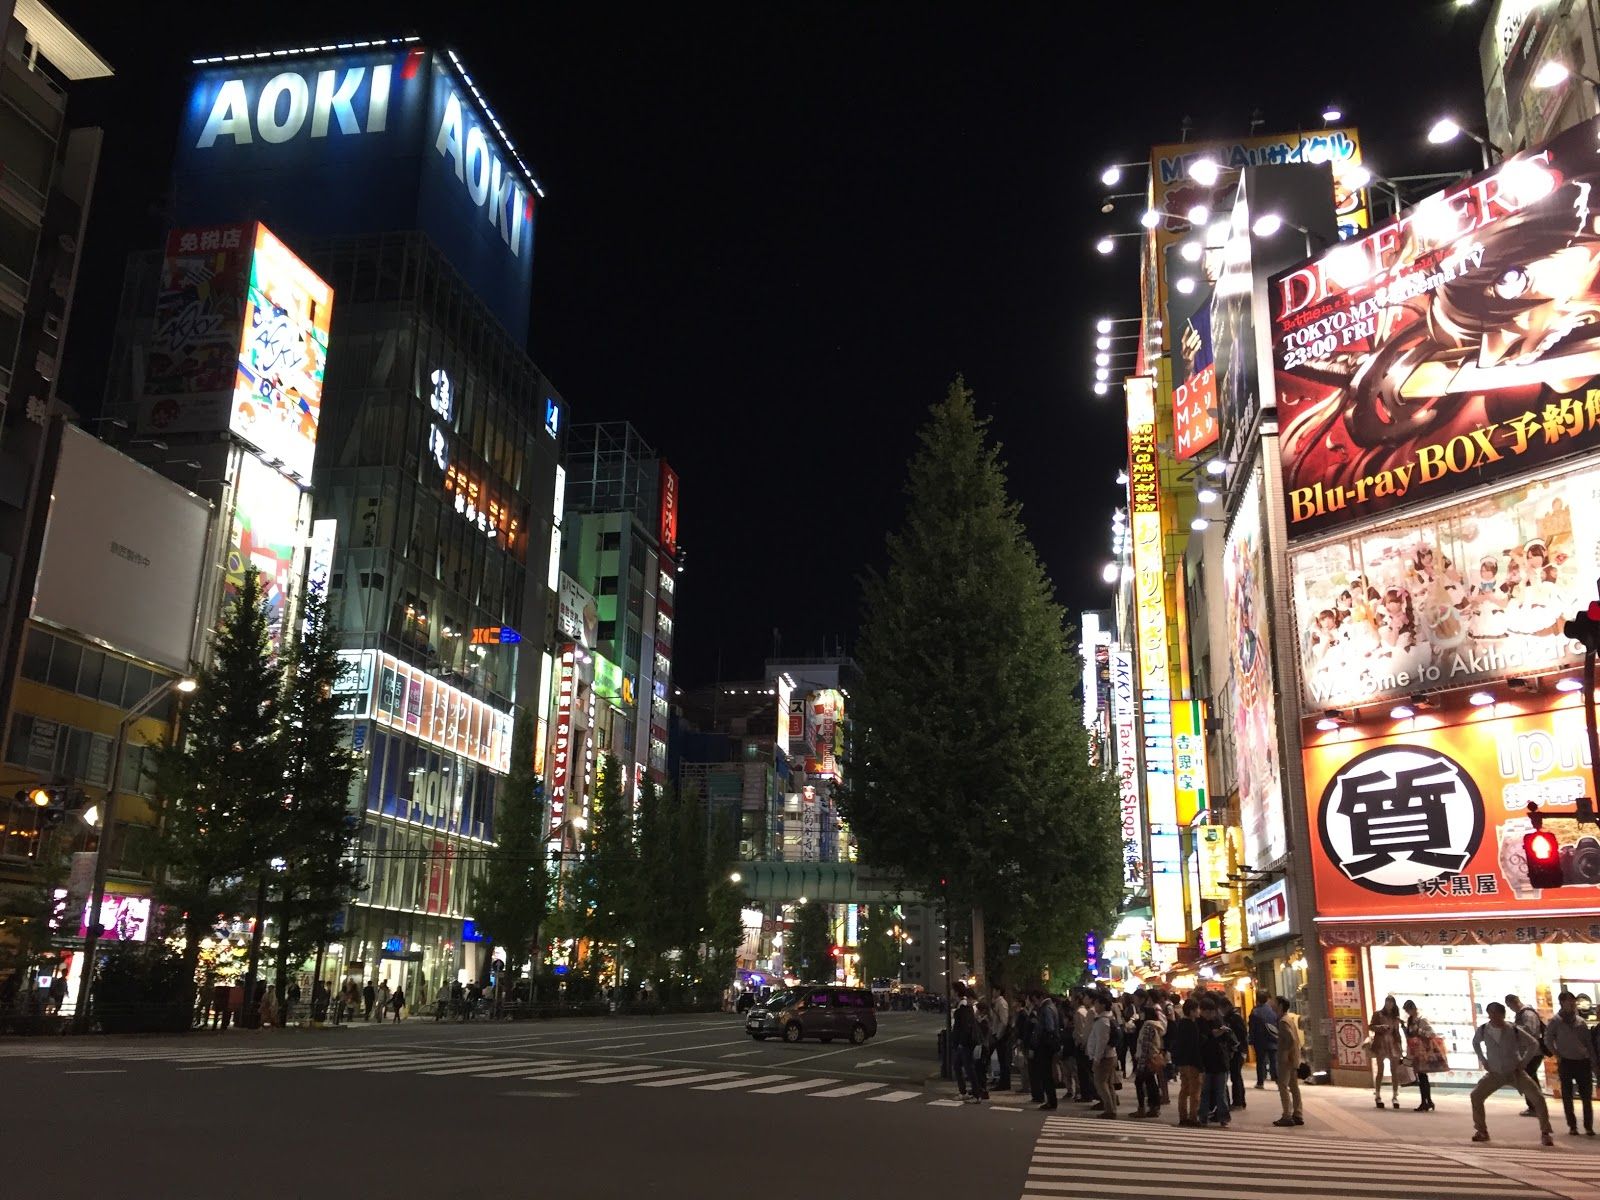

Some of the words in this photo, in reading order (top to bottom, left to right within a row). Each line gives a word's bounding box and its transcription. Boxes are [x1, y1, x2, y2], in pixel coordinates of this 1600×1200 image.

[195, 64, 393, 148] AOKI
[435, 91, 521, 257] AOKI
[180, 229, 242, 252] 免税店
[1283, 309, 1347, 351] TOKYO
[1283, 334, 1339, 371] 23:00
[1342, 317, 1375, 346] FRI
[1133, 473, 1155, 482] アニメ
[1135, 454, 1151, 463] CD
[665, 473, 675, 544] カラオケ
[1115, 656, 1131, 704] AKKY
[1417, 662, 1441, 683] to
[1119, 721, 1135, 790] Tax-free
[412, 771, 455, 818] AOK
[1121, 794, 1137, 840] Shop
[1336, 761, 1470, 880] 質
[1427, 874, 1498, 897] 大黒屋
